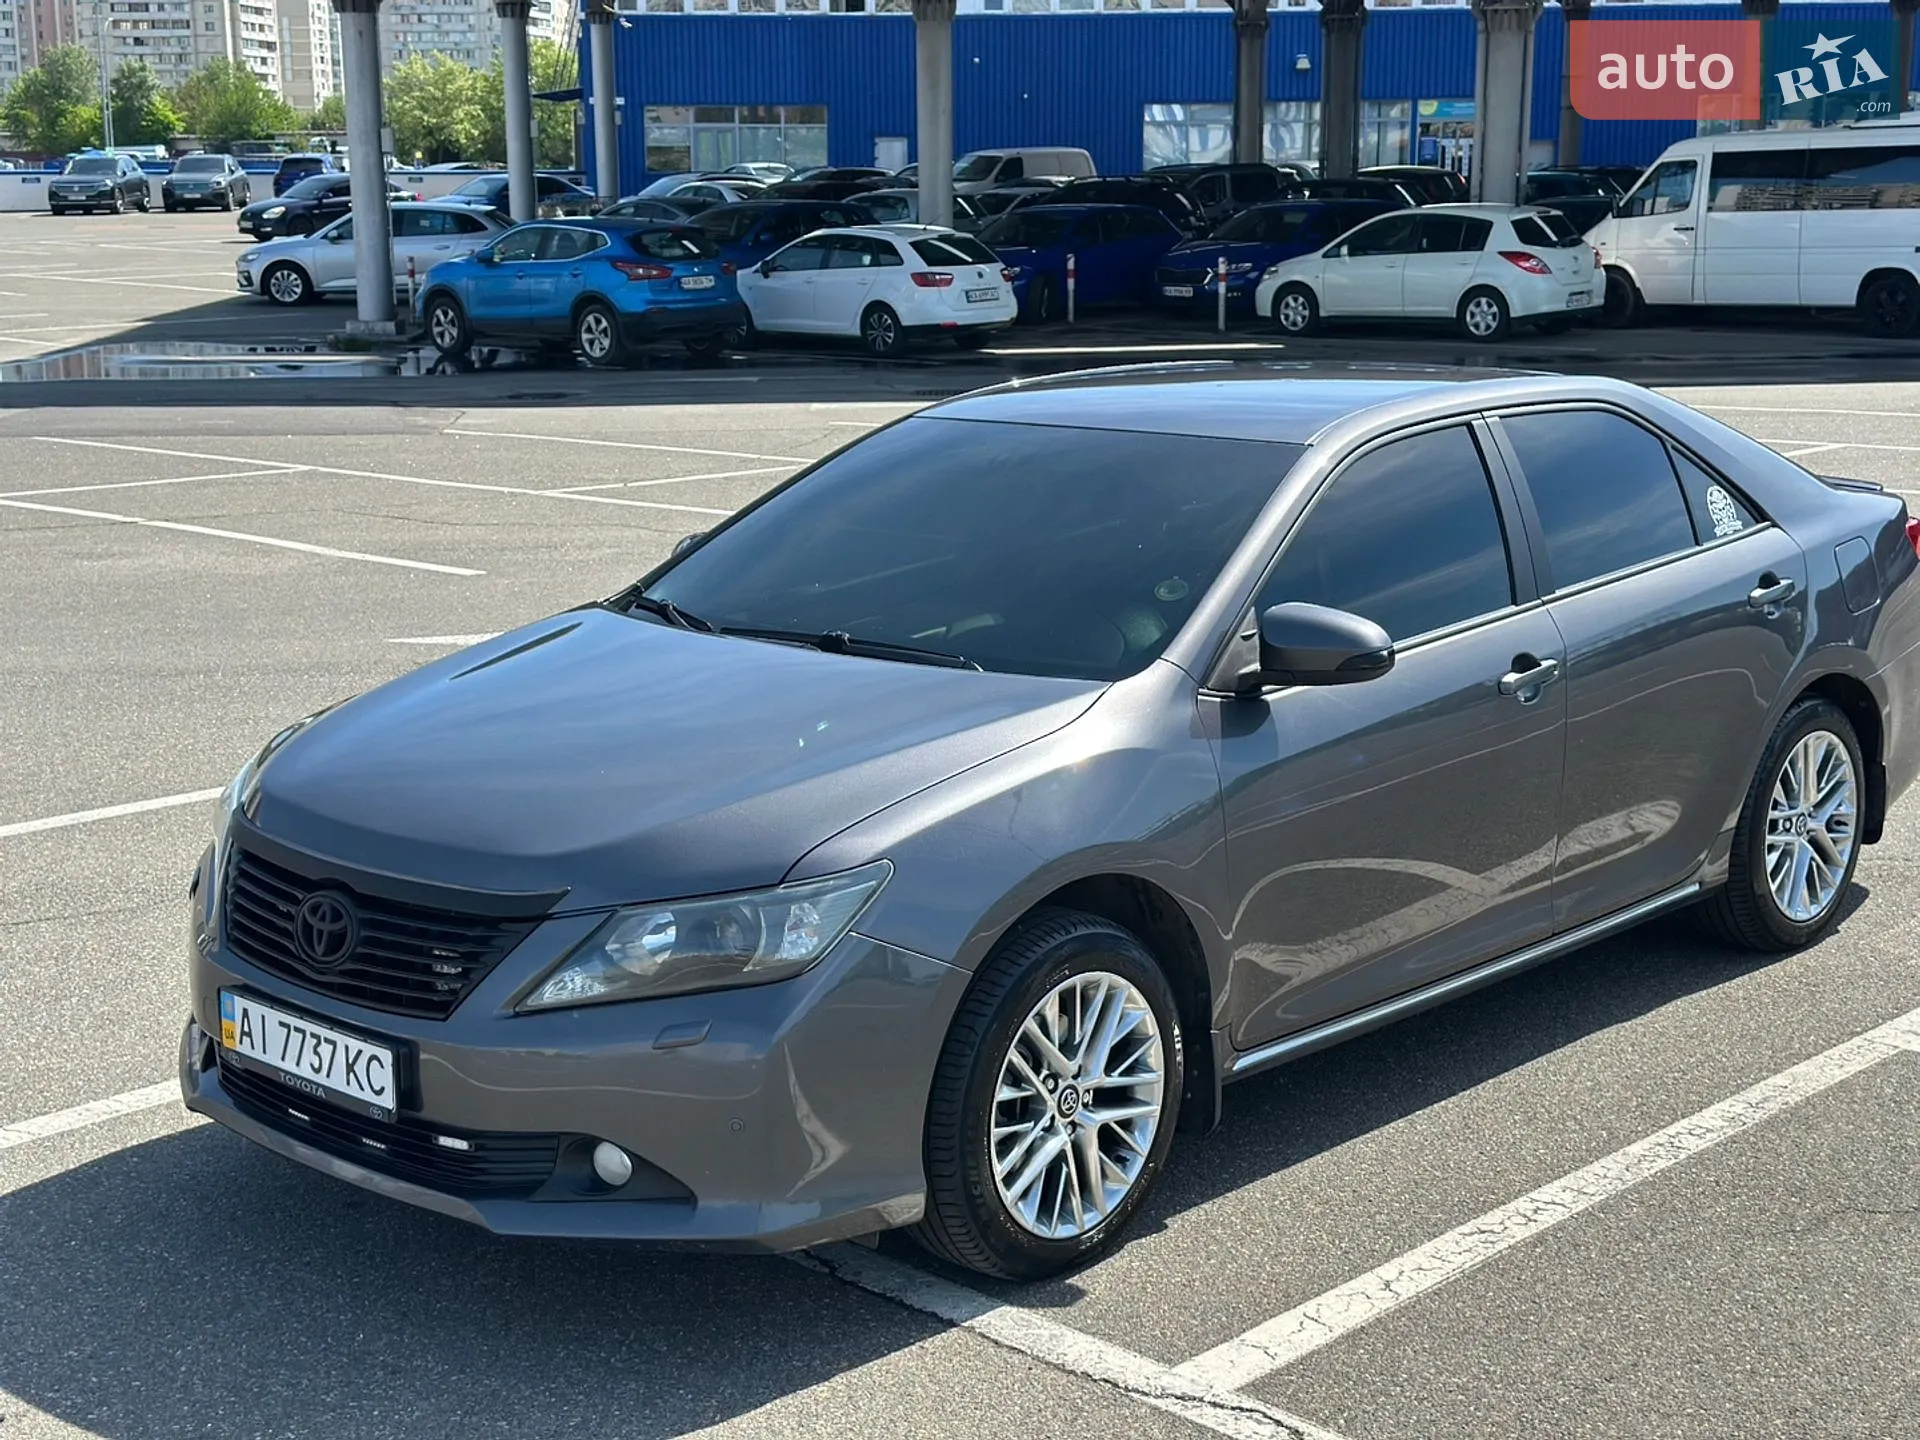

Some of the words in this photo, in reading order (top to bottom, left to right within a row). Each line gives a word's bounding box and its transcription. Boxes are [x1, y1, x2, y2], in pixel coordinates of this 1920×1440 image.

[224, 1027, 236, 1043] UA
[239, 1006, 267, 1055] AI
[278, 1020, 338, 1079] 7737
[344, 1043, 386, 1097] KC
[279, 1071, 327, 1099] TOYOTA
